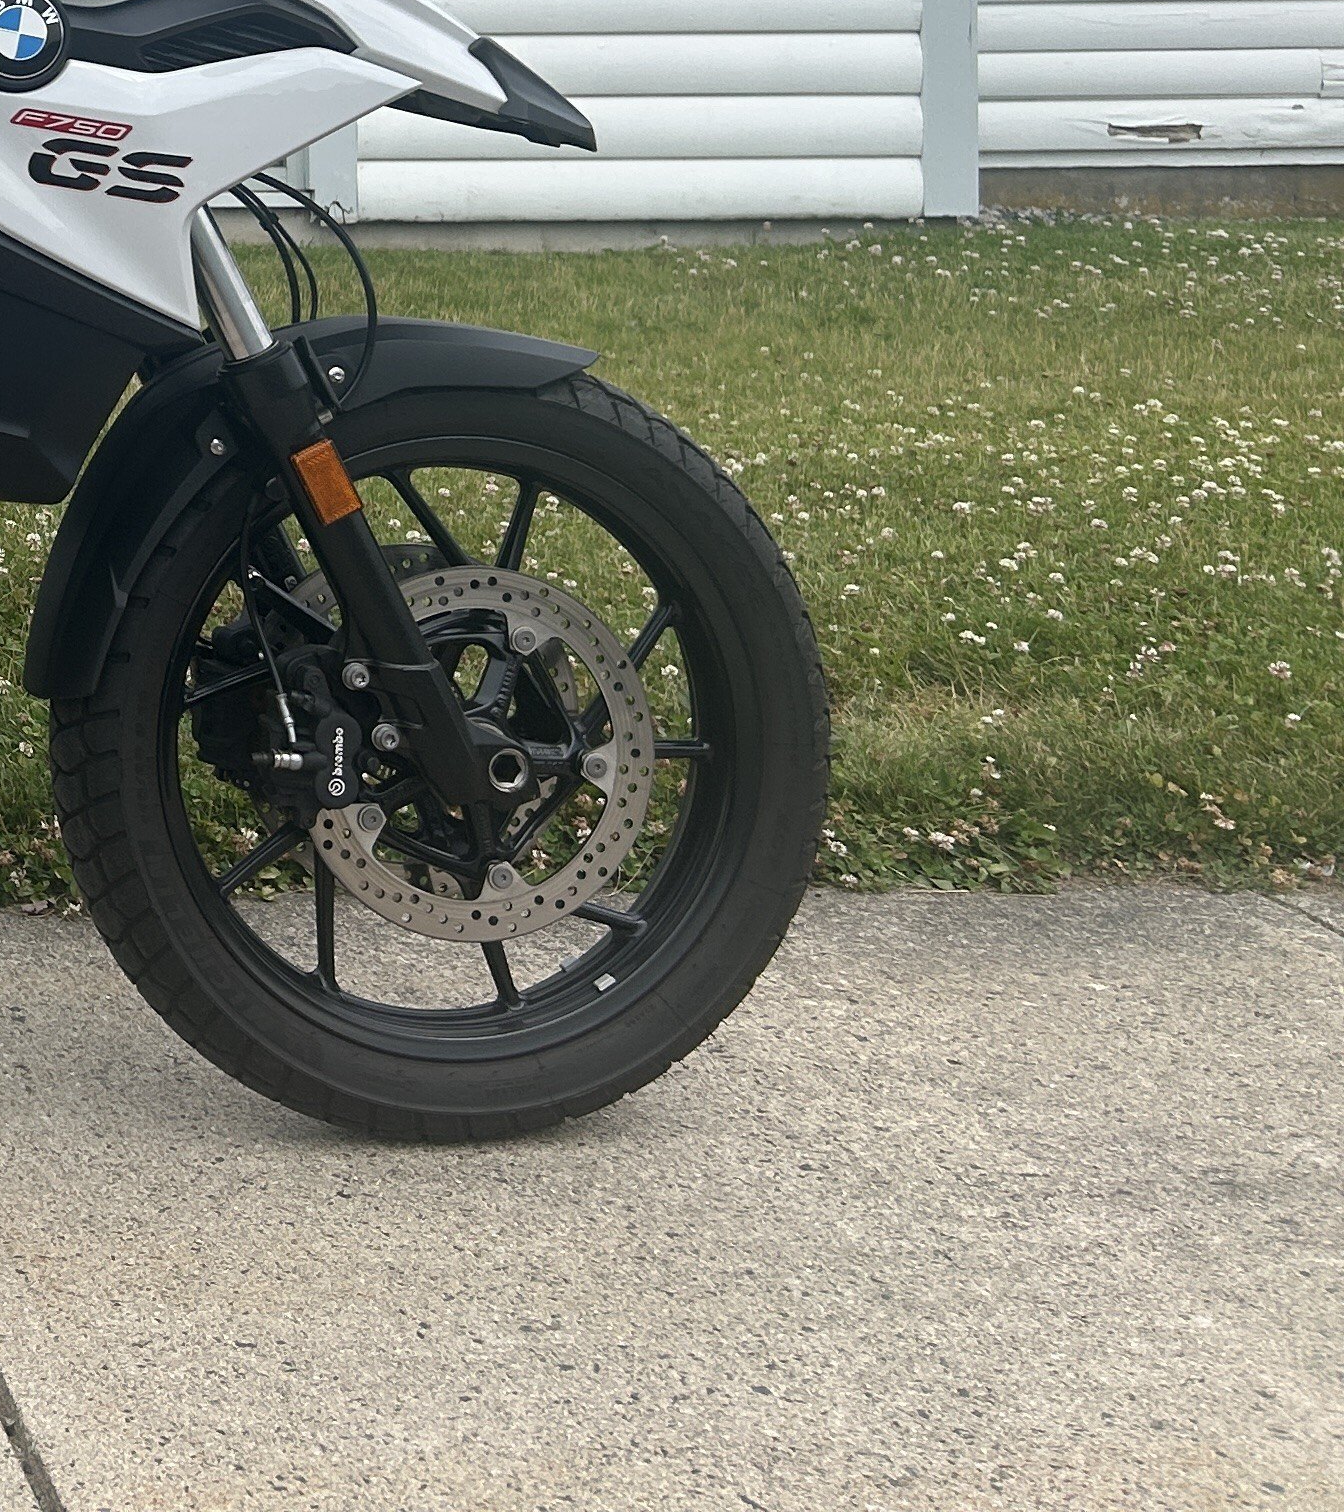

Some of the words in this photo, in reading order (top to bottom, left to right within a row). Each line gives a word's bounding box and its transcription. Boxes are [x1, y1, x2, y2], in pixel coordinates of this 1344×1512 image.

[14, 110, 128, 139] F750
[28, 138, 193, 203] GS
[332, 727, 344, 776] brembo
